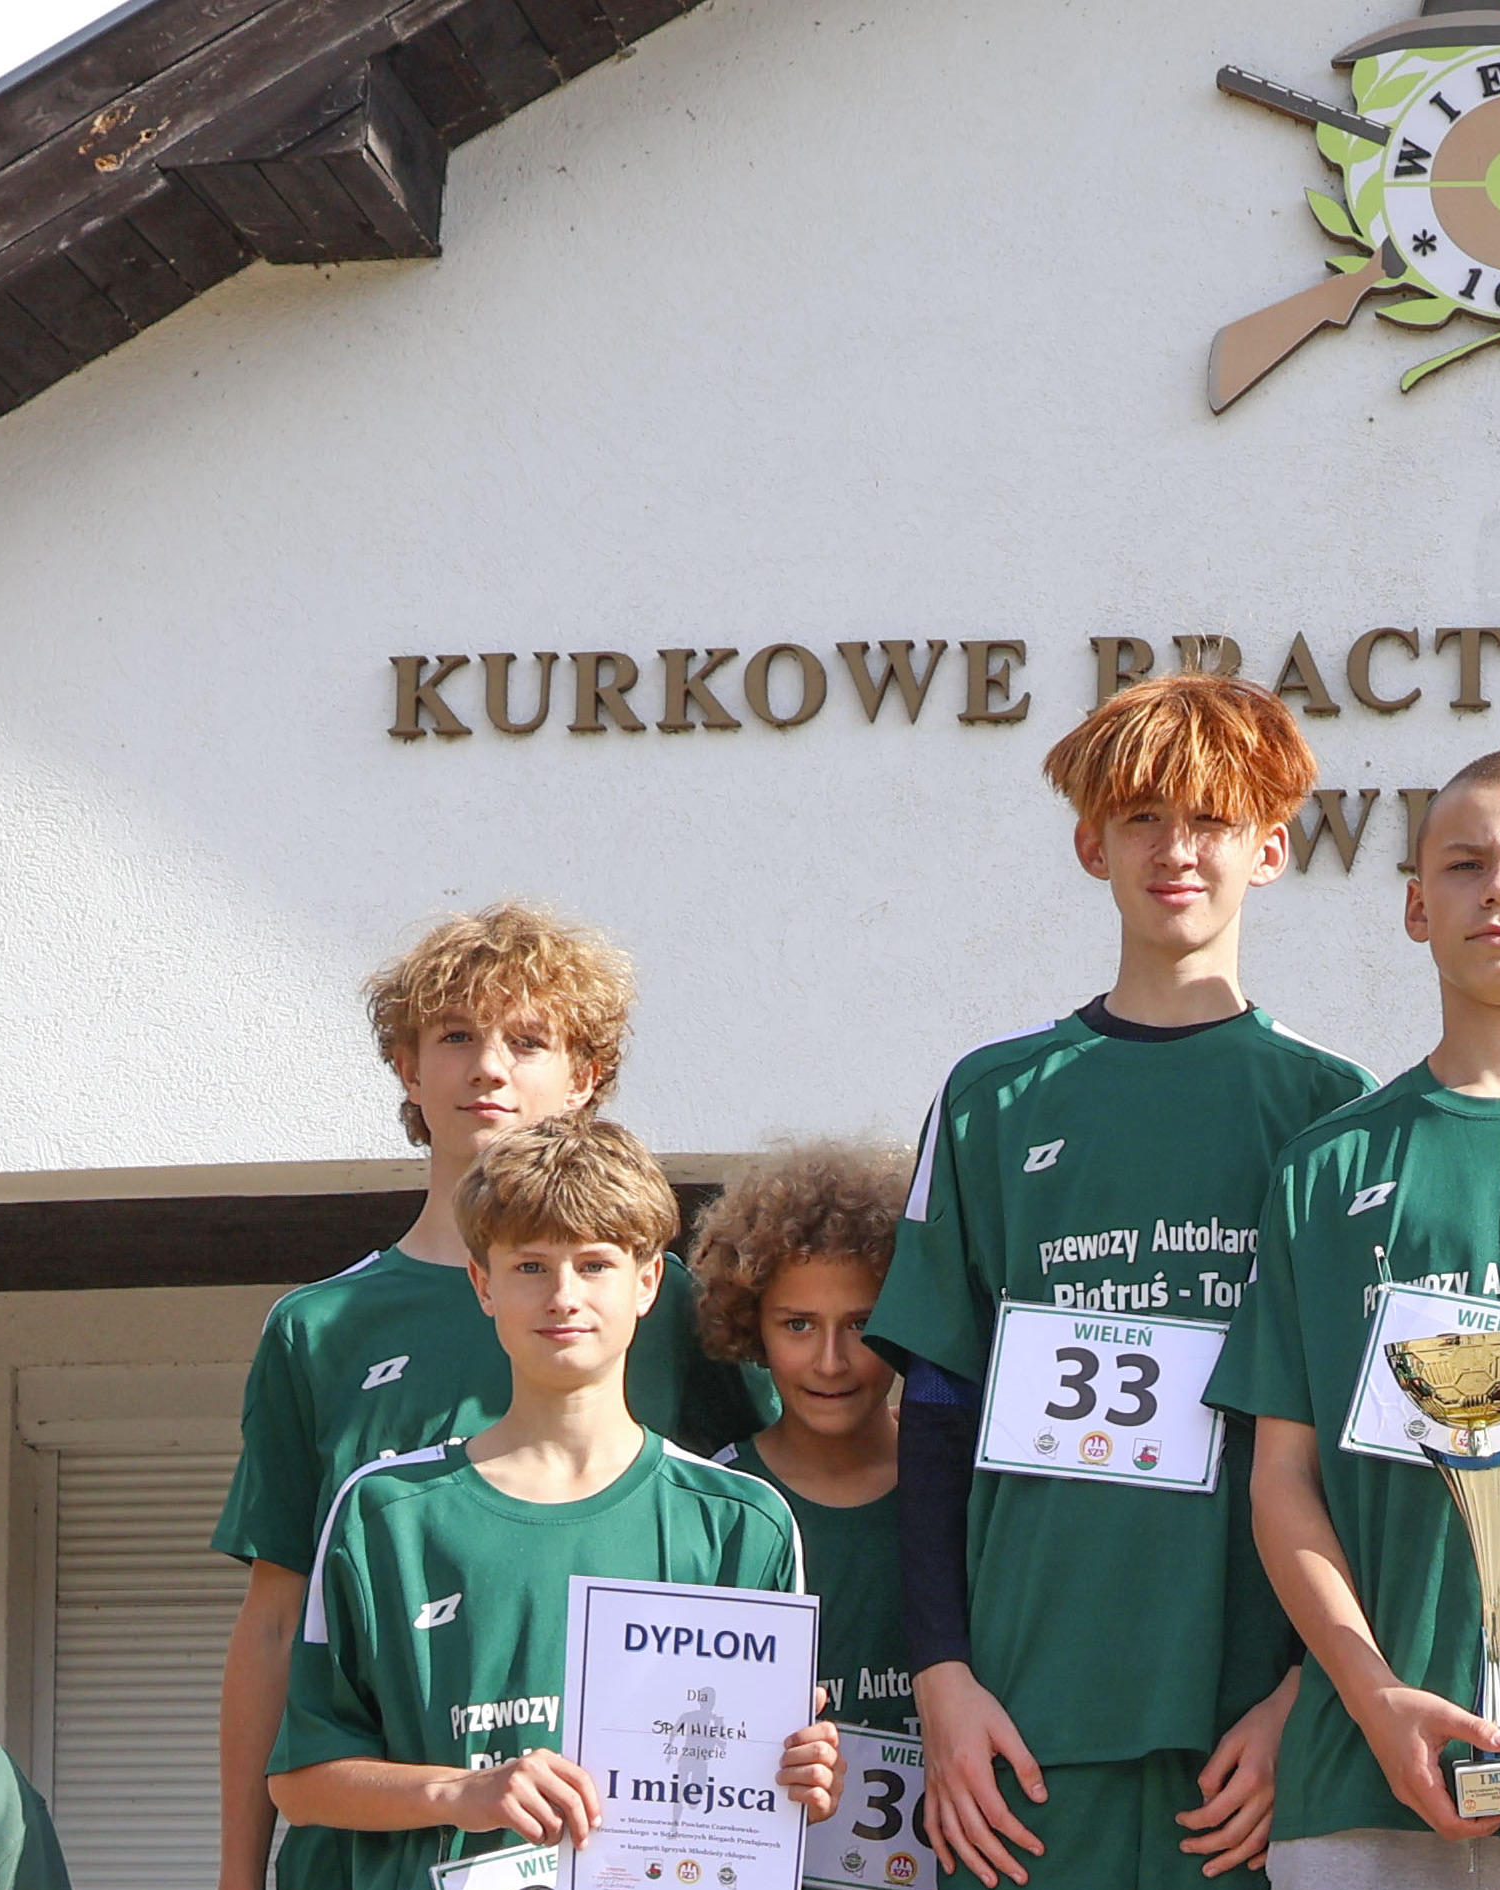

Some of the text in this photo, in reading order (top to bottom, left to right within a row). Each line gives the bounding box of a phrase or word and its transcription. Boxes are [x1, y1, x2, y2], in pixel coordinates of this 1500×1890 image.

[386, 638, 1033, 740] KURKOWE
[1054, 1271, 1169, 1311] Piotruś
[1074, 1322, 1153, 1347] WIELEŃ
[1044, 1346, 1160, 1427] 33
[624, 1622, 777, 1663] DYPLOM
[686, 1689, 708, 1702] Dla
[451, 1696, 560, 1740] Przewozy
[662, 1743, 727, 1760] Za zajęcie
[881, 1745, 925, 1768] WIEL
[607, 1769, 777, 1814] I miejsca
